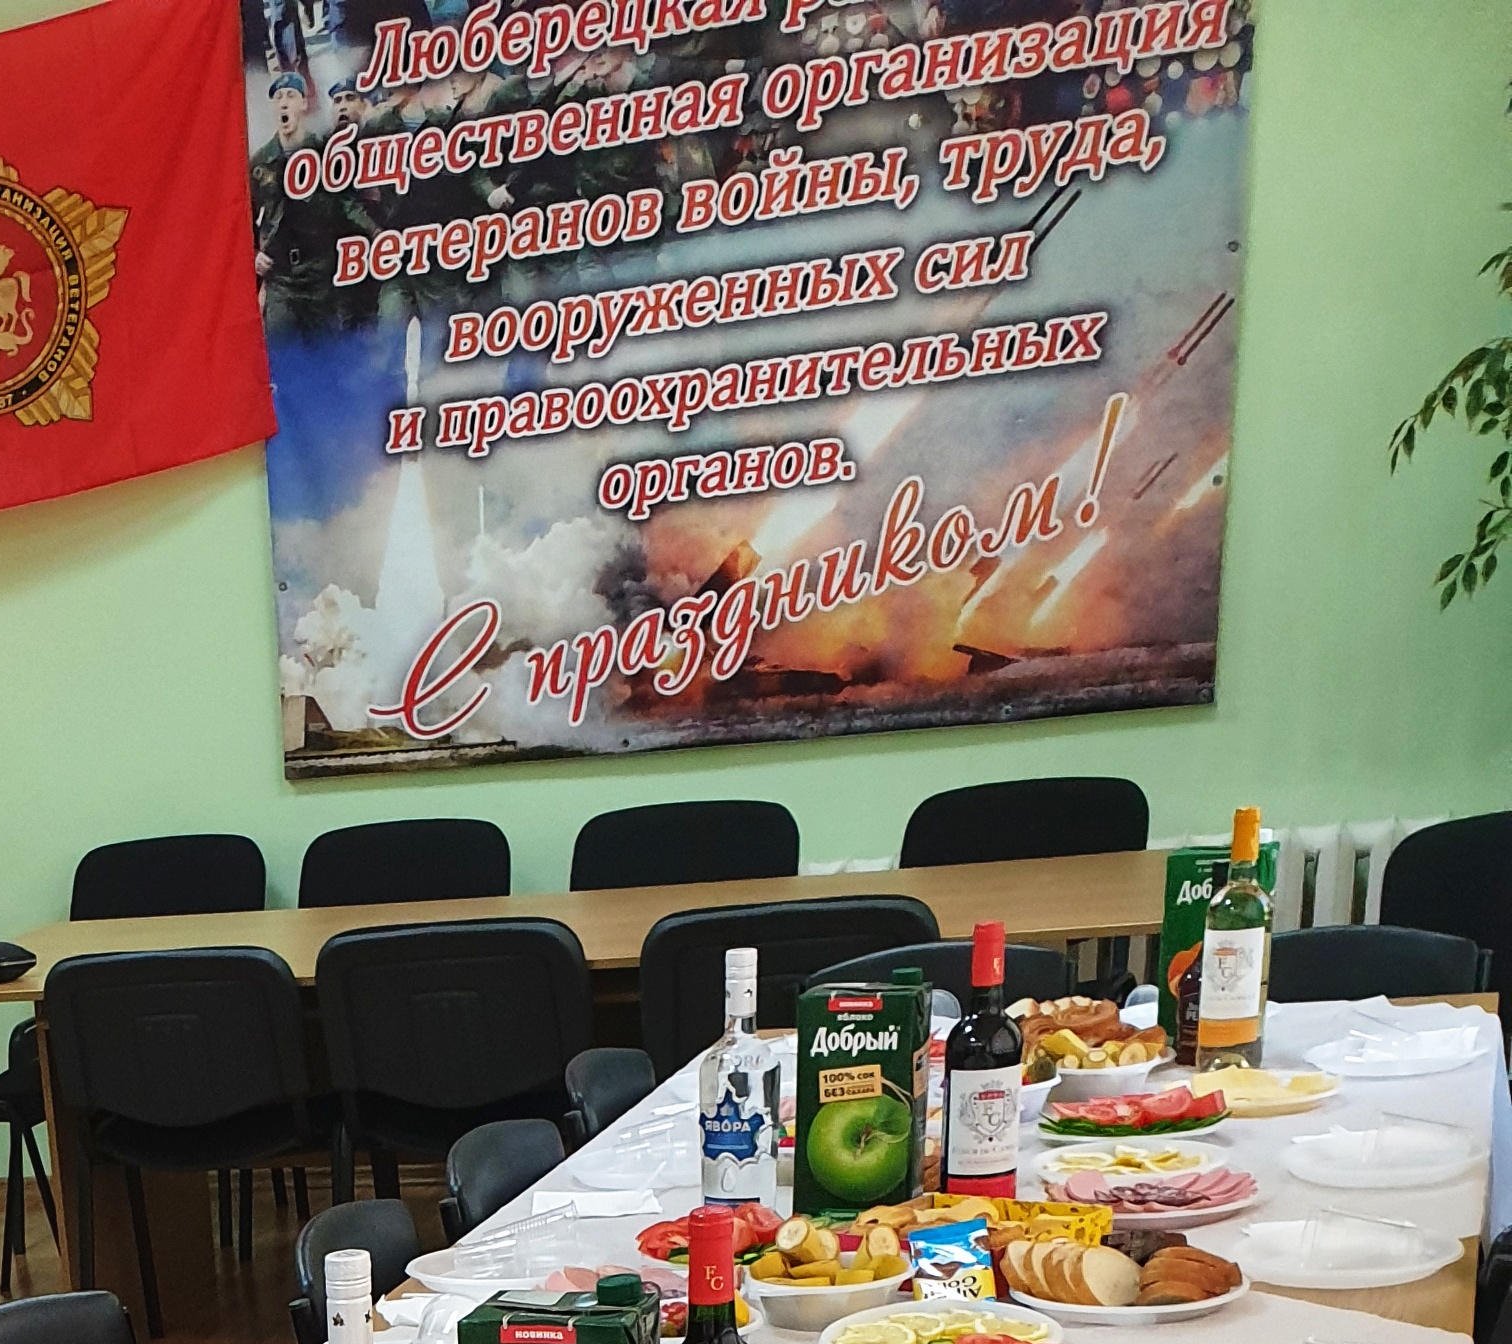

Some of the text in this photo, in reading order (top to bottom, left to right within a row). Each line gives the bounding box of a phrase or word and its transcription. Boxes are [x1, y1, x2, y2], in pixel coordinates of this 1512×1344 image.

[284, 0, 1230, 200] общественная организация
[333, 107, 1166, 287] ветеранов войны, труда,
[37, 274, 80, 385] ВЕТЕРАНОВ
[445, 231, 1035, 362] вооруженных сил
[386, 312, 1108, 458] и правоохранительных
[598, 435, 856, 520] органов.
[369, 394, 1127, 740] С праздником!
[1176, 877, 1213, 906] Доб
[810, 1023, 899, 1058] Добрый
[822, 1072, 855, 1084] 100%
[514, 1330, 564, 1341] новинка
